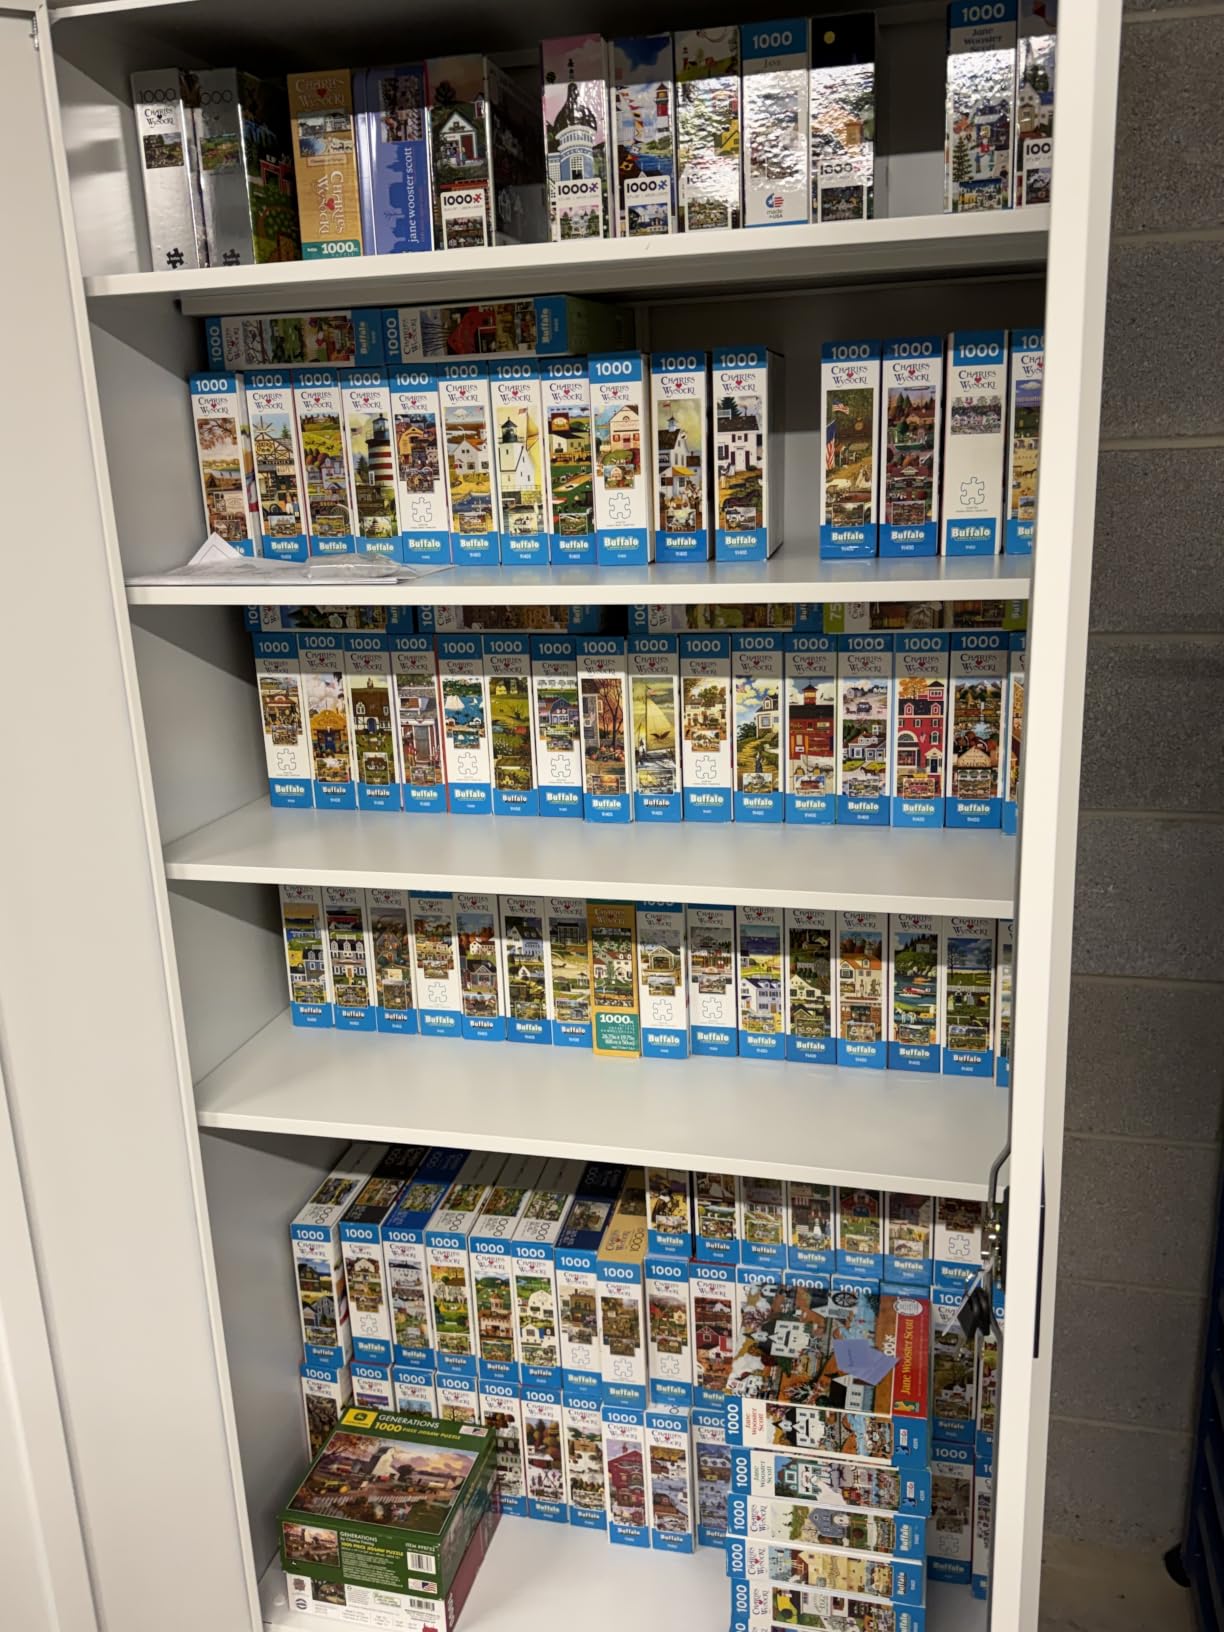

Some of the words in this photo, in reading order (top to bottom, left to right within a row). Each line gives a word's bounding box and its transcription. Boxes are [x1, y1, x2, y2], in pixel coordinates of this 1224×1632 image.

[960, 3, 1005, 22] 1000
[752, 31, 792, 48] 1000
[1026, 142, 1051, 155] 100
[404, 148, 414, 174] scott
[558, 184, 588, 196] 1000
[626, 181, 656, 193] 1000
[406, 175, 416, 220] wooster
[444, 194, 472, 206] 1000
[408, 220, 419, 243] jane
[322, 242, 354, 254] 1000
[387, 317, 398, 356] 1000
[210, 326, 222, 362] 1000
[892, 342, 932, 356] 1000
[832, 345, 870, 359] 1000
[960, 344, 998, 358] 1000
[660, 357, 696, 370] 1000
[720, 353, 758, 366] 1000
[445, 365, 478, 378] 1000
[497, 364, 531, 378] 1000
[548, 364, 582, 377] 1000
[596, 362, 632, 376] 1000
[251, 375, 282, 388] 1000
[300, 374, 332, 386] 1000
[348, 372, 380, 386] 1000
[396, 372, 428, 385] 1000
[196, 379, 228, 392] 1000
[832, 532, 864, 541] Buffalo
[891, 530, 925, 540] Buffalo
[952, 528, 990, 538] Buffalo
[272, 542, 298, 550] Buffalo
[320, 542, 347, 550] Buffalo
[408, 540, 440, 549] Buffalo
[460, 540, 488, 548] Buffalo
[510, 540, 539, 550] Buffalo
[560, 540, 588, 550] Buffalo
[604, 538, 639, 548] Buffalo
[666, 538, 696, 546] Buffalo
[725, 536, 757, 546] Buffalo
[366, 544, 394, 552] Buffalo
[259, 642, 289, 654] 1000
[304, 636, 335, 648] 1000
[350, 638, 380, 650] 1000
[396, 638, 426, 650] 1000
[444, 642, 475, 654] 1000
[490, 640, 522, 652] 1000
[584, 642, 616, 654] 1000
[634, 640, 668, 652] 1000
[686, 640, 720, 652] 1000
[740, 637, 774, 649] 1000
[793, 638, 828, 650] 1000
[848, 638, 884, 650] 1000
[904, 638, 942, 650] 1000
[961, 636, 1000, 648] 1000
[540, 643, 571, 655] 1000
[274, 784, 304, 794] Buffalo
[323, 786, 346, 794] Buffalo
[366, 789, 390, 797] Buffalo
[411, 790, 438, 799] Buffalo
[454, 790, 486, 800] Buffalo
[502, 794, 527, 804] Buffalo
[546, 792, 578, 802] Buffalo
[644, 798, 670, 807] Buffalo
[690, 794, 724, 804] Buffalo
[743, 798, 773, 808] Buffalo
[593, 800, 622, 808] Buffalo
[795, 800, 826, 810] Buffalo
[848, 802, 879, 812] Buffalo
[902, 804, 934, 814] Buffalo
[958, 804, 990, 814] Buffalo
[300, 1007, 322, 1015] Buffalo
[342, 1010, 364, 1018] Buffalo
[385, 1013, 408, 1022] Buffalo
[424, 1016, 455, 1026] Buffalo
[600, 1014, 630, 1024] 1000
[470, 1020, 494, 1028] Buffalo
[516, 1023, 542, 1032] Buffalo
[561, 1026, 586, 1035] Buffalo
[648, 1034, 680, 1044] Buffalo
[697, 1032, 730, 1043] Buffalo
[748, 1036, 776, 1046] Buffalo
[796, 1040, 826, 1050] Buffalo
[846, 1044, 876, 1054] Buffalo
[899, 1048, 930, 1058] Buffalo
[953, 1054, 982, 1064] Buffalo
[296, 1230, 324, 1240] 1000
[345, 1228, 373, 1240] 1000
[388, 1232, 416, 1242] 1000
[431, 1238, 458, 1248] 1000
[475, 1242, 504, 1254] 1000
[516, 1248, 545, 1258] 1000
[561, 1257, 590, 1268] 1000
[604, 1268, 634, 1279] 1000
[652, 1266, 682, 1278] 1000
[696, 1268, 728, 1280] 1000
[744, 1274, 774, 1284] 1000
[792, 1278, 823, 1289] 1000
[840, 1284, 872, 1295] 1000
[306, 1368, 332, 1380] 1000
[355, 1368, 382, 1379] 1000
[399, 1373, 426, 1384] 1000
[442, 1378, 470, 1390] 1000
[484, 1385, 513, 1396] 1000
[526, 1391, 554, 1402] 1000
[568, 1398, 597, 1410] 1000
[378, 1414, 440, 1429] GENERATIONS
[608, 1412, 637, 1424] 1000
[652, 1418, 682, 1430] 1000
[728, 1404, 740, 1434] 1000
[374, 1422, 402, 1432] 1000
[935, 1448, 967, 1460] 1000
[736, 1457, 748, 1487] 1000
[734, 1500, 745, 1530] 1000
[901, 1524, 910, 1550] Buffalo
[732, 1544, 744, 1573] 1000
[736, 1584, 748, 1614] 1000
